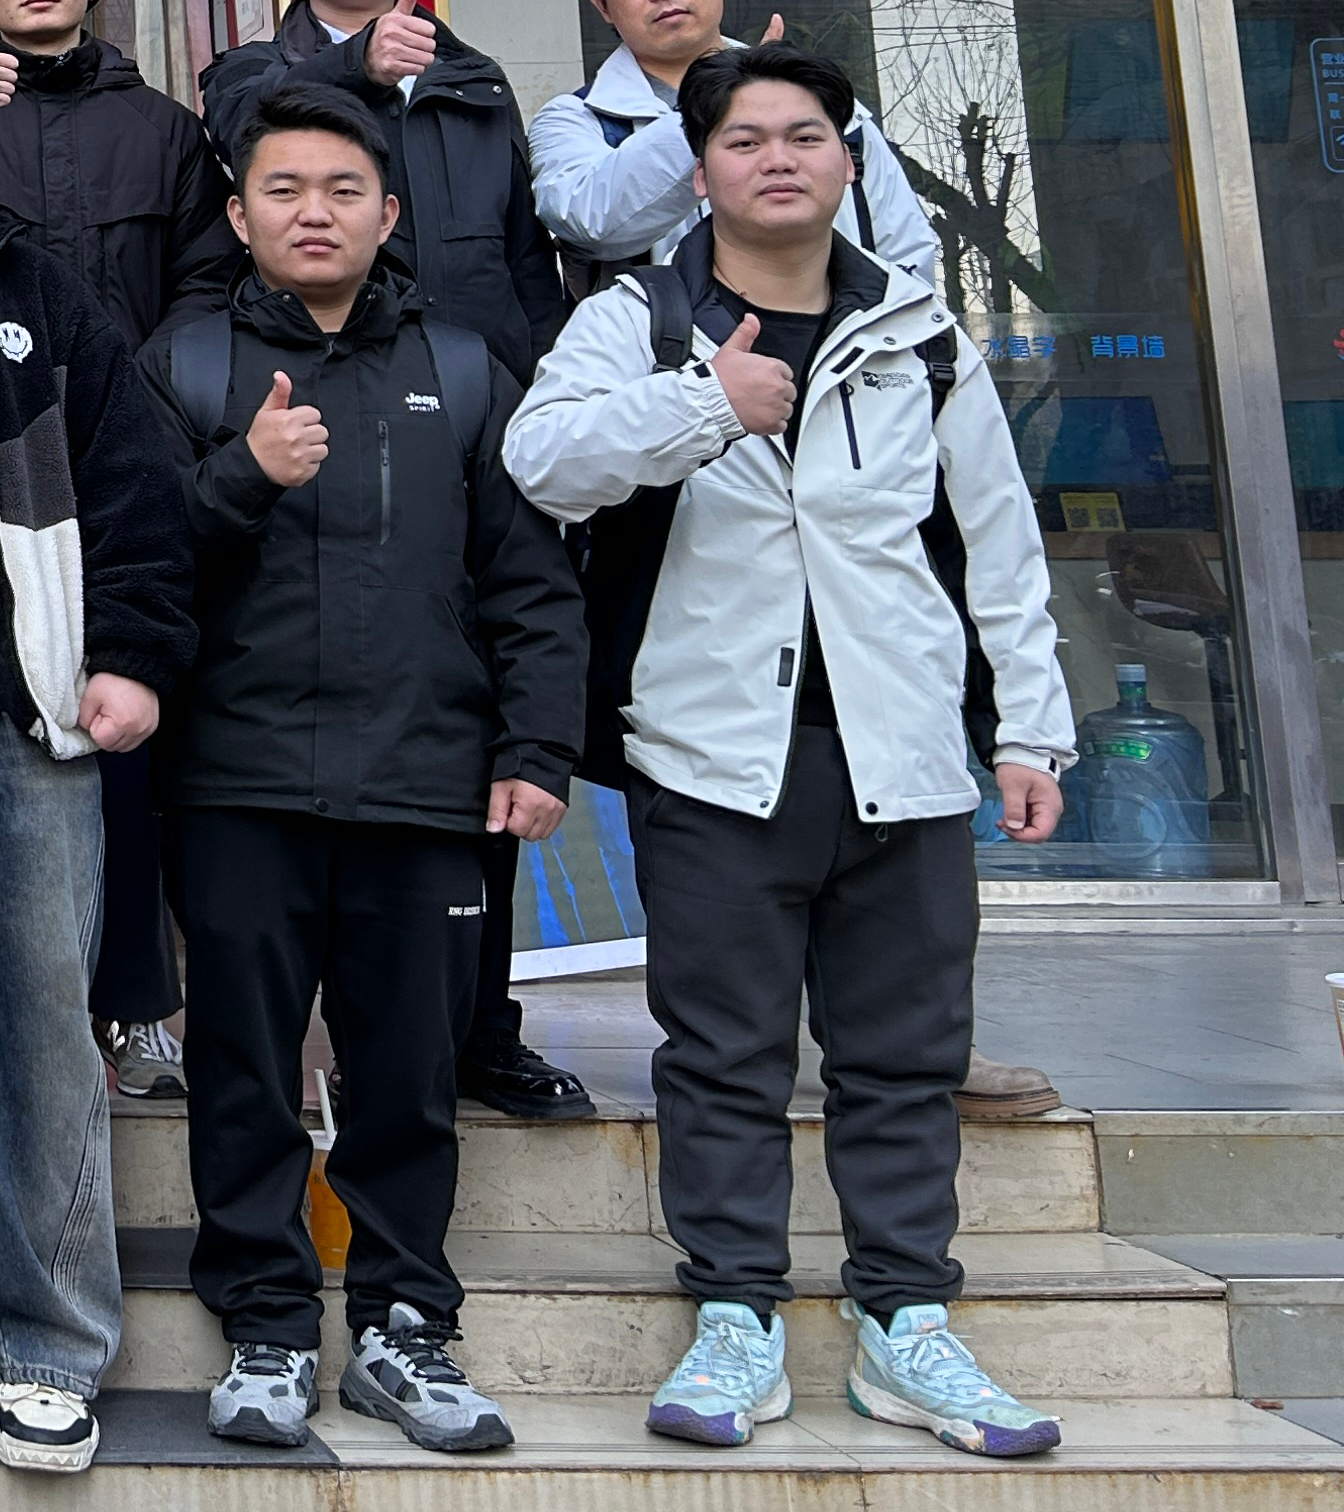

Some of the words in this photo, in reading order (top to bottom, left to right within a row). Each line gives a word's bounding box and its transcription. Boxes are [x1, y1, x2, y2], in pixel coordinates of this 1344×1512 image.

[1090, 335, 1166, 359] 背景墙
[405, 392, 439, 407] Jeep
